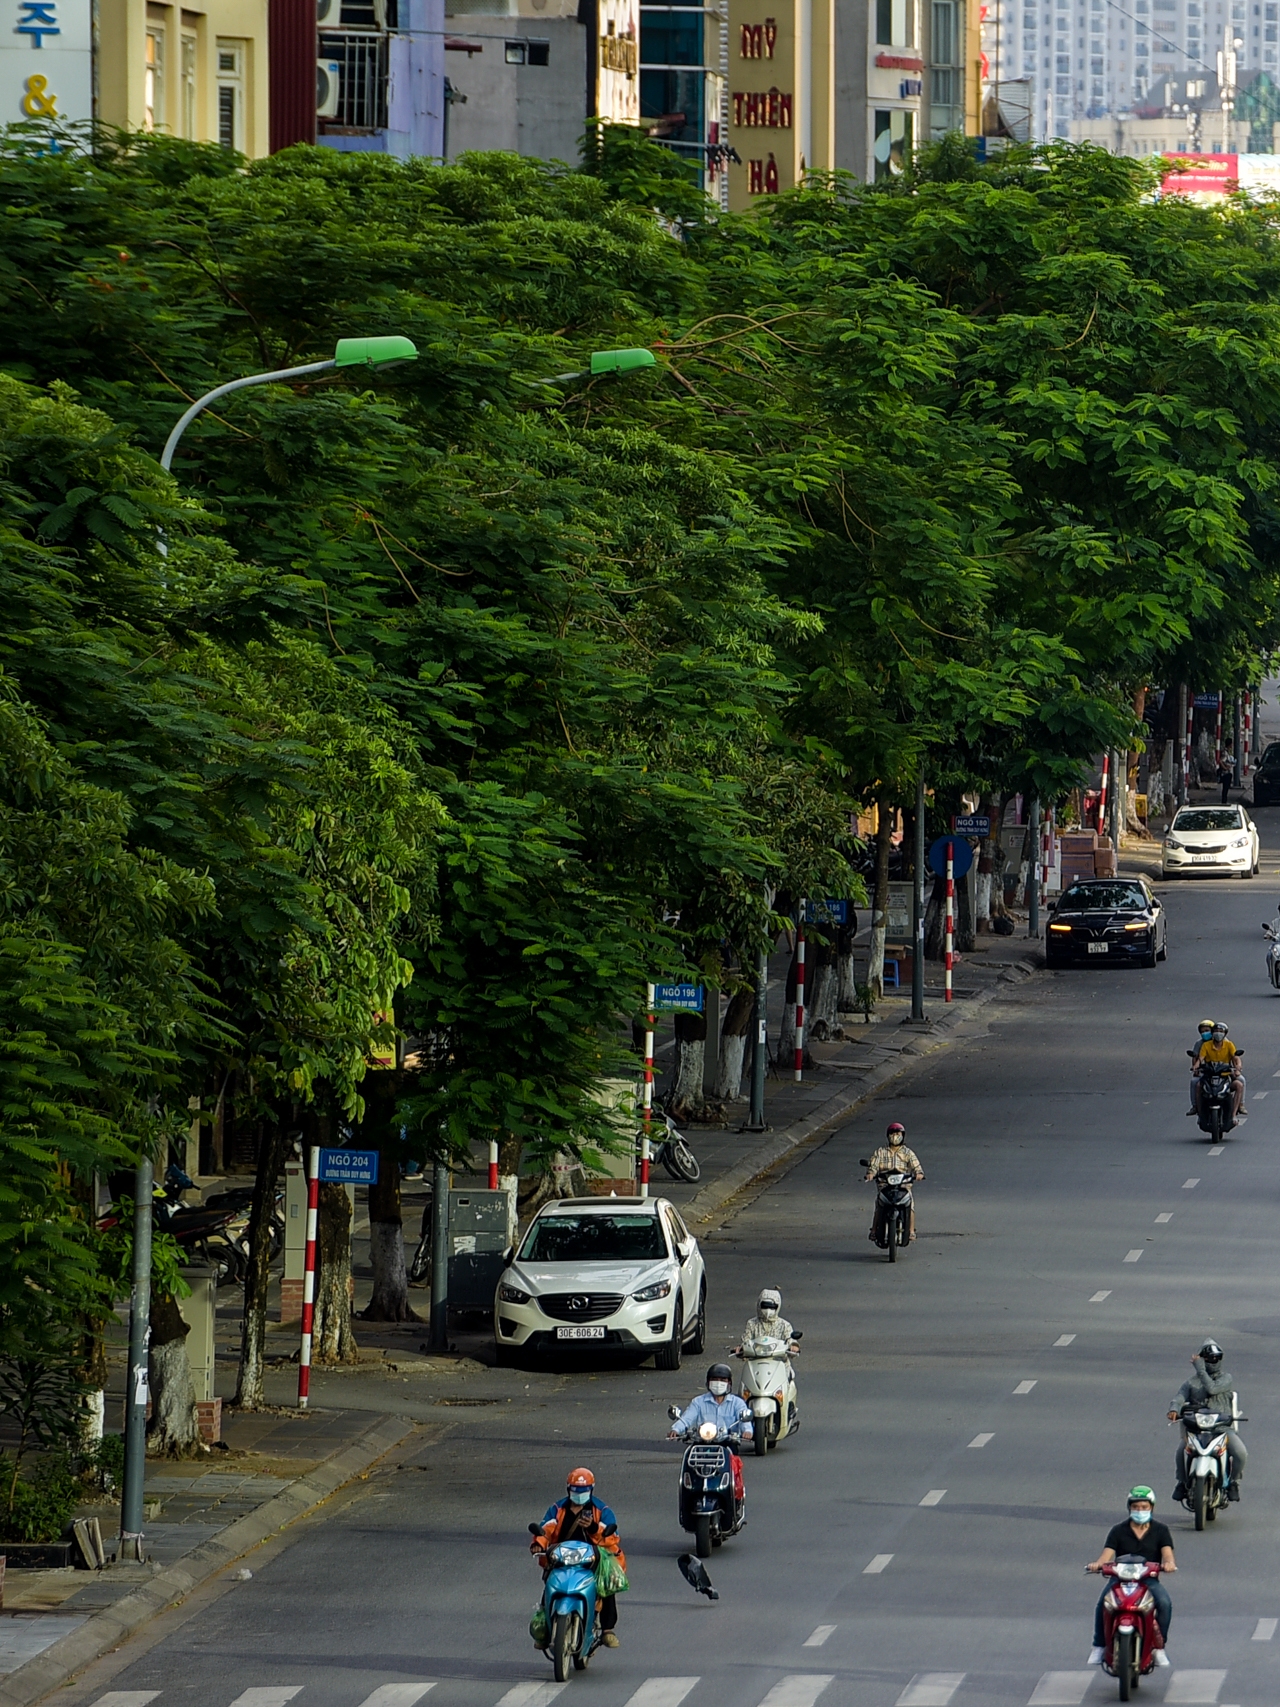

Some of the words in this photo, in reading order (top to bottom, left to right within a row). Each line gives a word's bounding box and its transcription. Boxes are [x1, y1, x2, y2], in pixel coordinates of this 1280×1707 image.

[17, 2, 60, 48] 주
[740, 17, 777, 59] MỸ
[24, 74, 58, 117] &
[733, 86, 792, 128] THIÊN
[748, 152, 778, 194] HÀ
[682, 989, 696, 998] 196
[328, 1153, 350, 1166] NGÕ
[352, 1156, 369, 1166] 204
[558, 1327, 604, 1338] 30E-606.24
